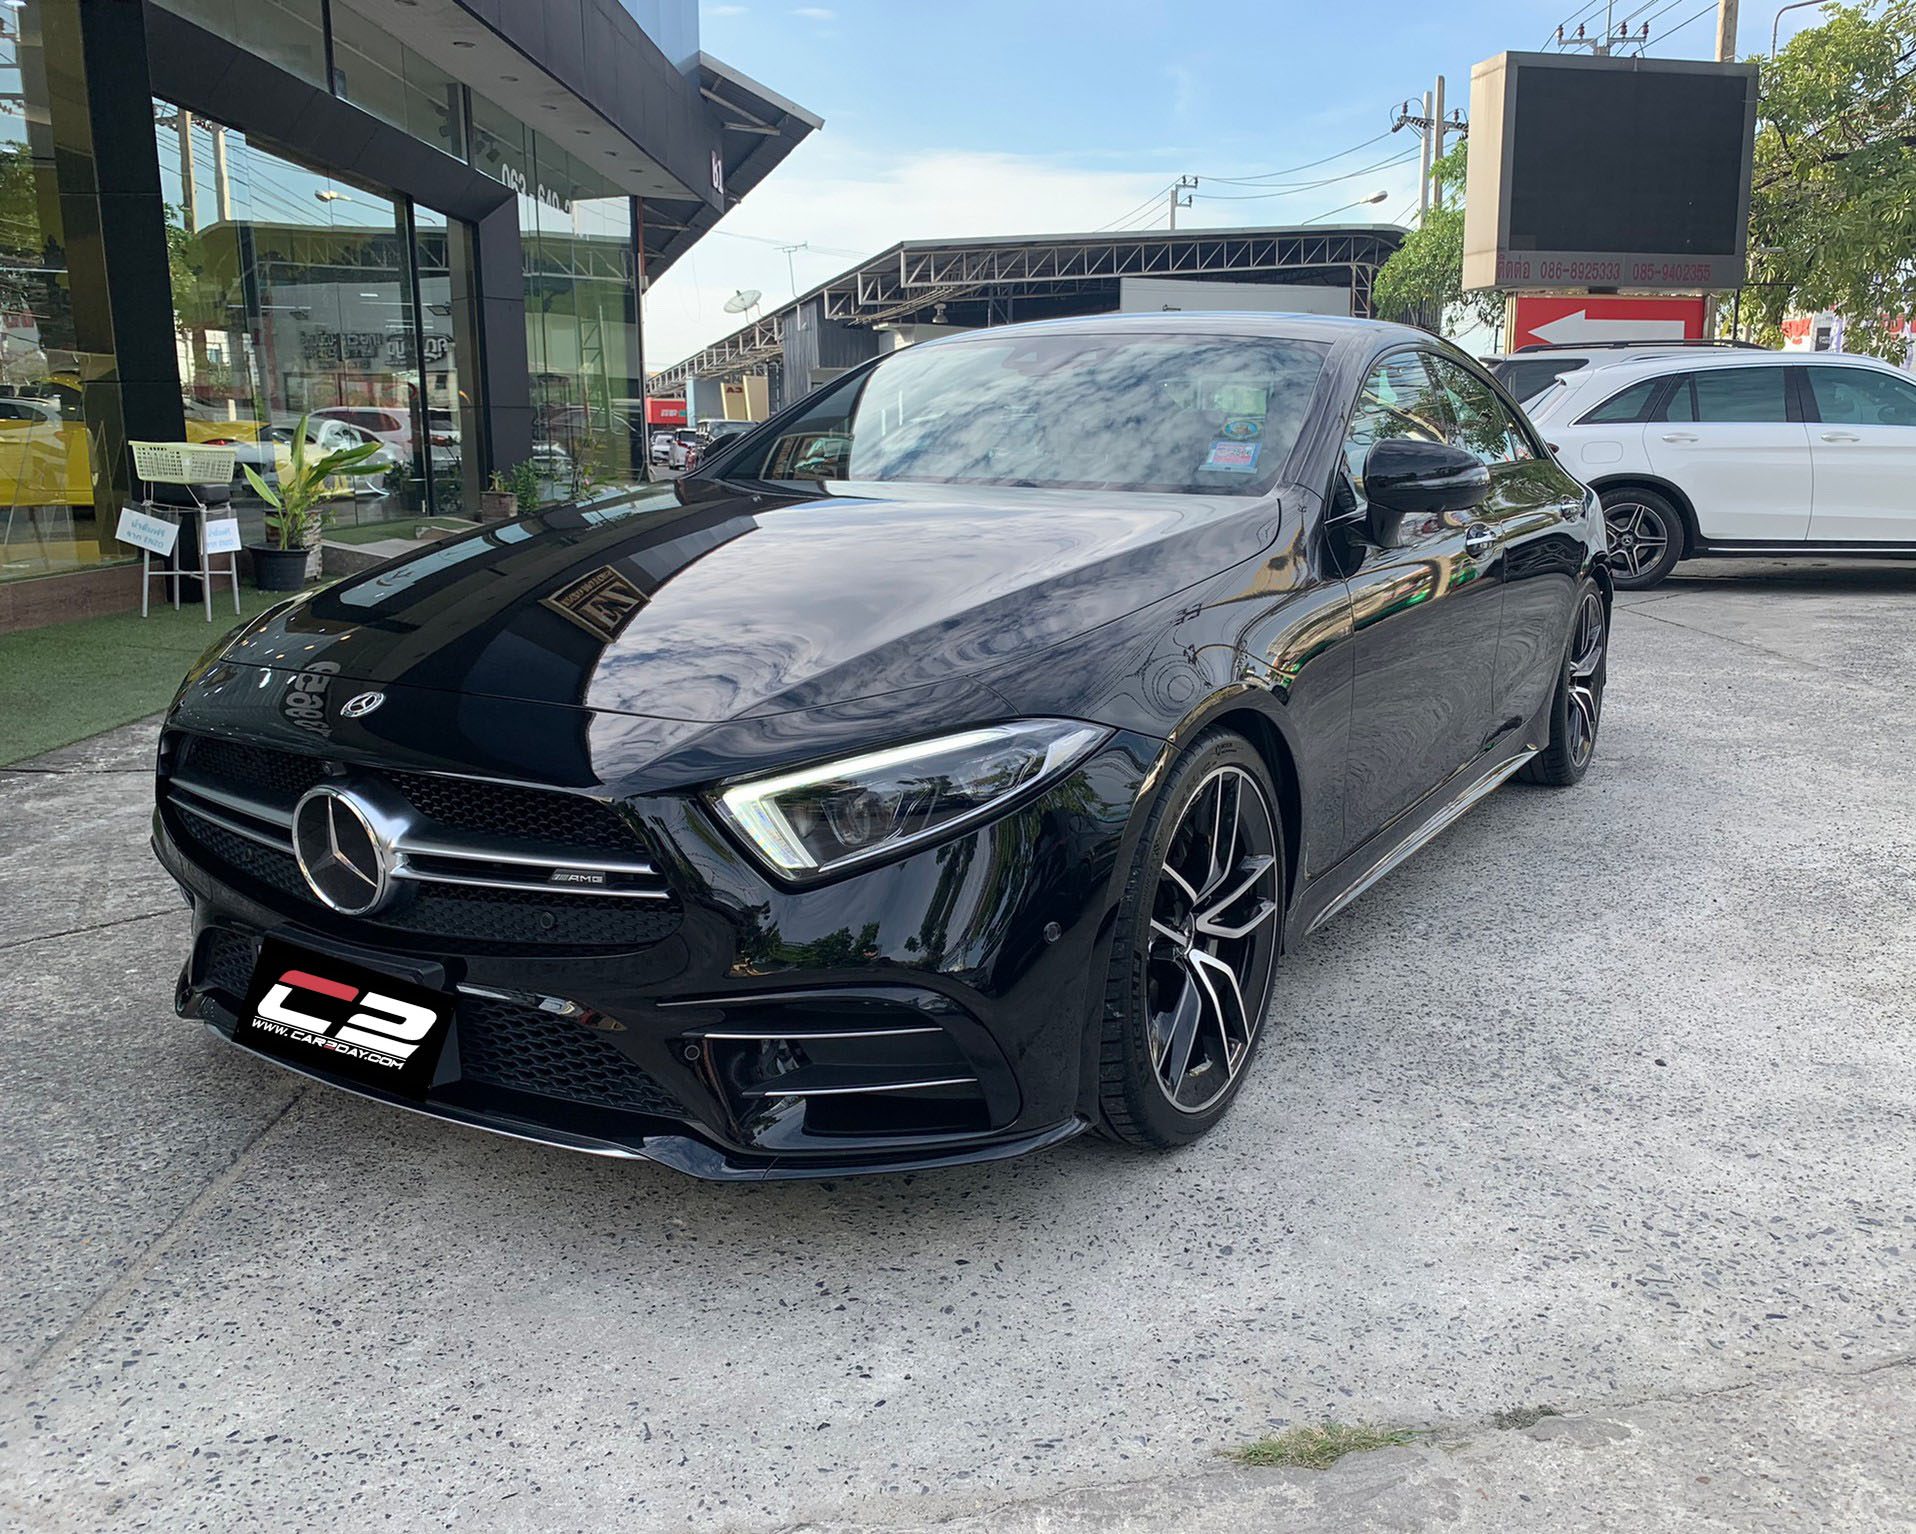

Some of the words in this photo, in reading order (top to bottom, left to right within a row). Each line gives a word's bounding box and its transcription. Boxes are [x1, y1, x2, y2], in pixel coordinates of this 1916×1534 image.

[1540, 262, 1620, 280] 086-8925333
[726, 386, 743, 394] A3
[567, 874, 604, 884] AMG
